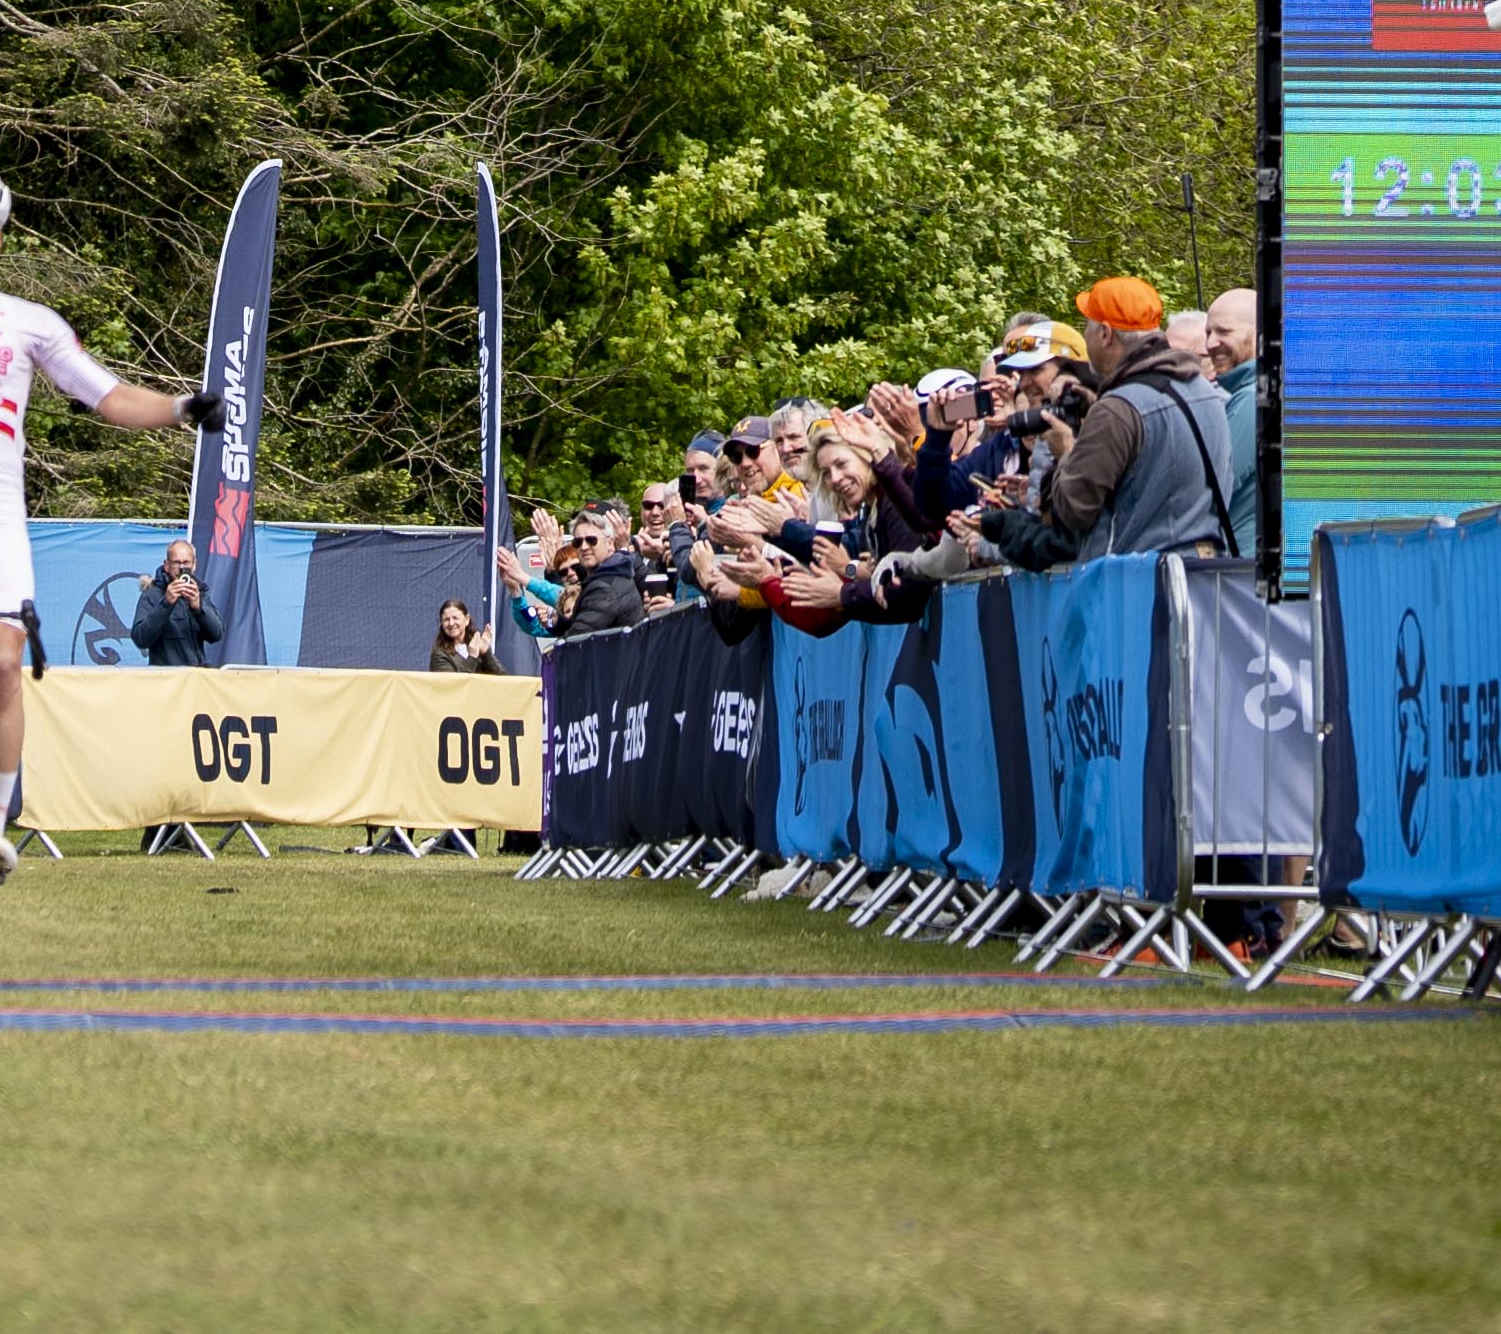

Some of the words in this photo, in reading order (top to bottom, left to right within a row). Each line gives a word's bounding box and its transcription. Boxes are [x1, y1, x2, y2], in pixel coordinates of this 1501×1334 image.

[191, 712, 279, 786] OGT
[436, 716, 525, 787] OGT
[1440, 683, 1472, 780] THE
